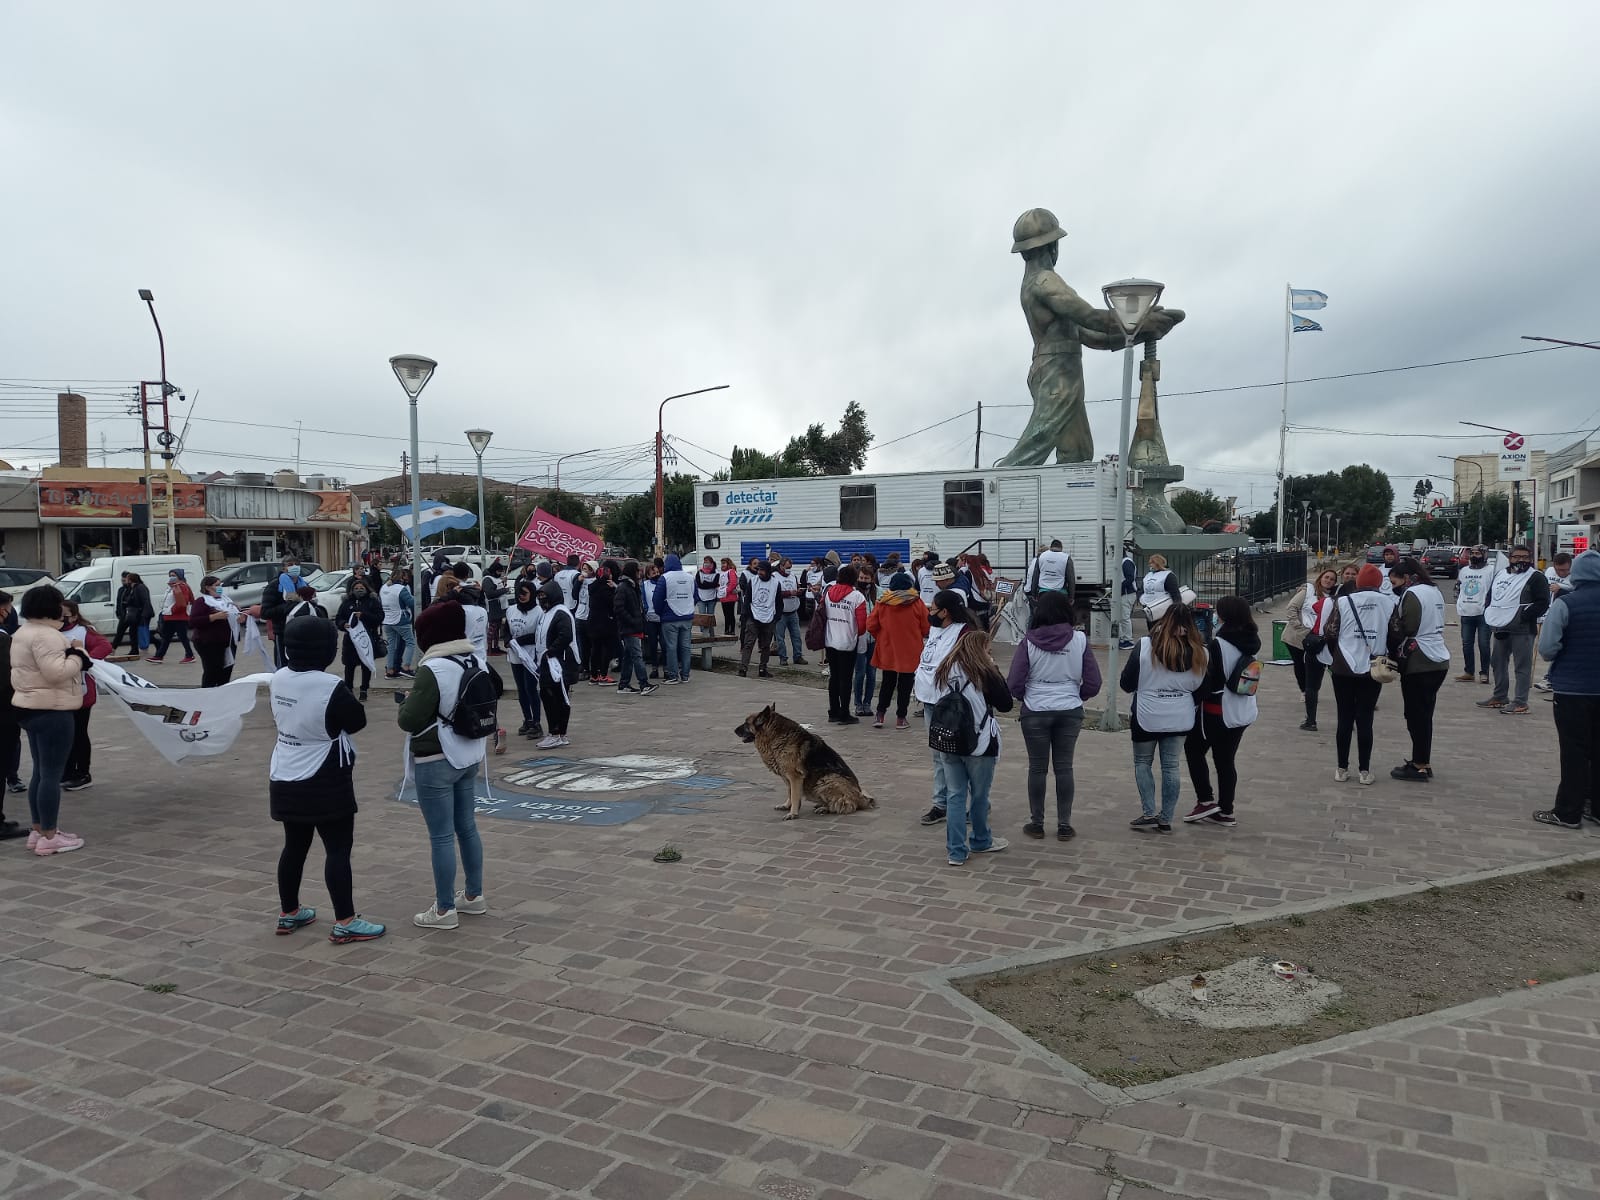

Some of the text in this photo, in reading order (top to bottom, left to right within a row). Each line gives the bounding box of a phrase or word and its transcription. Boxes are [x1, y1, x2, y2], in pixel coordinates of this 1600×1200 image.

[726, 490, 778, 505] detectar
[537, 521, 597, 555] TRIBUNA
[512, 802, 611, 815] SIGUEN
[529, 813, 583, 822] LOS
